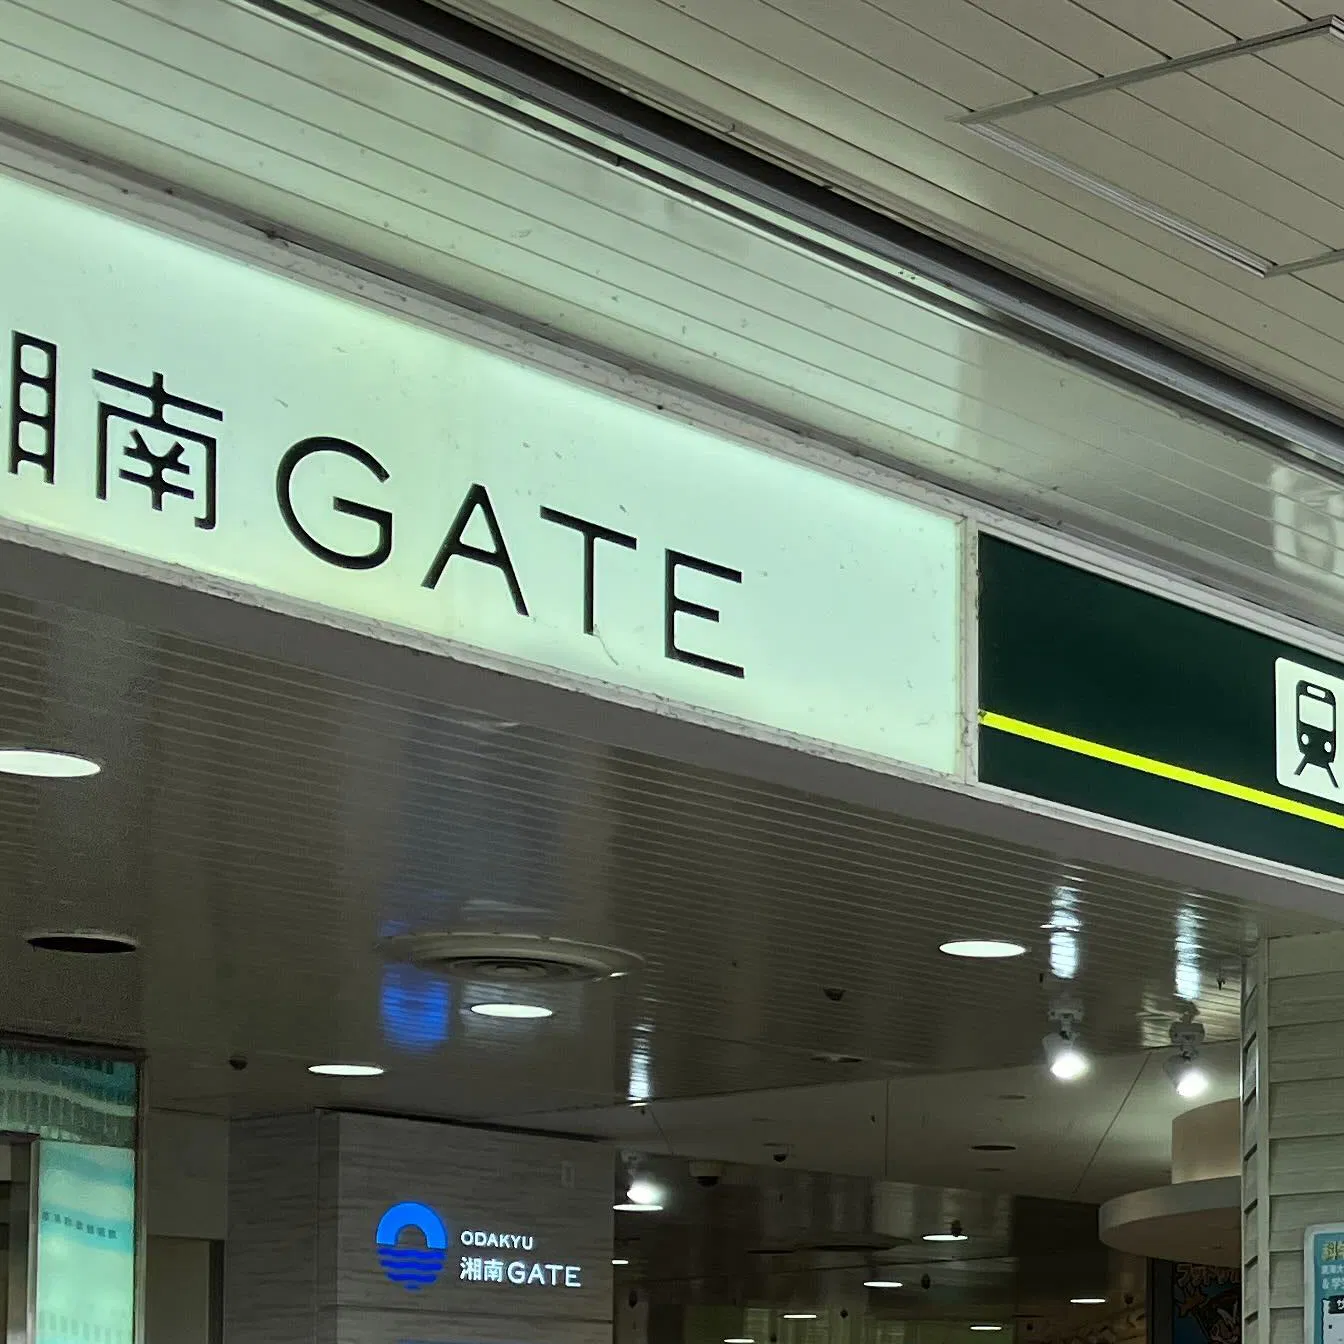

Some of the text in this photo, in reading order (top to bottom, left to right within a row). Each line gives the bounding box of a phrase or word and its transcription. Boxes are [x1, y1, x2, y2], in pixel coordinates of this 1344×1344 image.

[275, 435, 746, 680] GATE
[460, 1230, 534, 1251] ODAKYU
[507, 1261, 581, 1288] GATE
